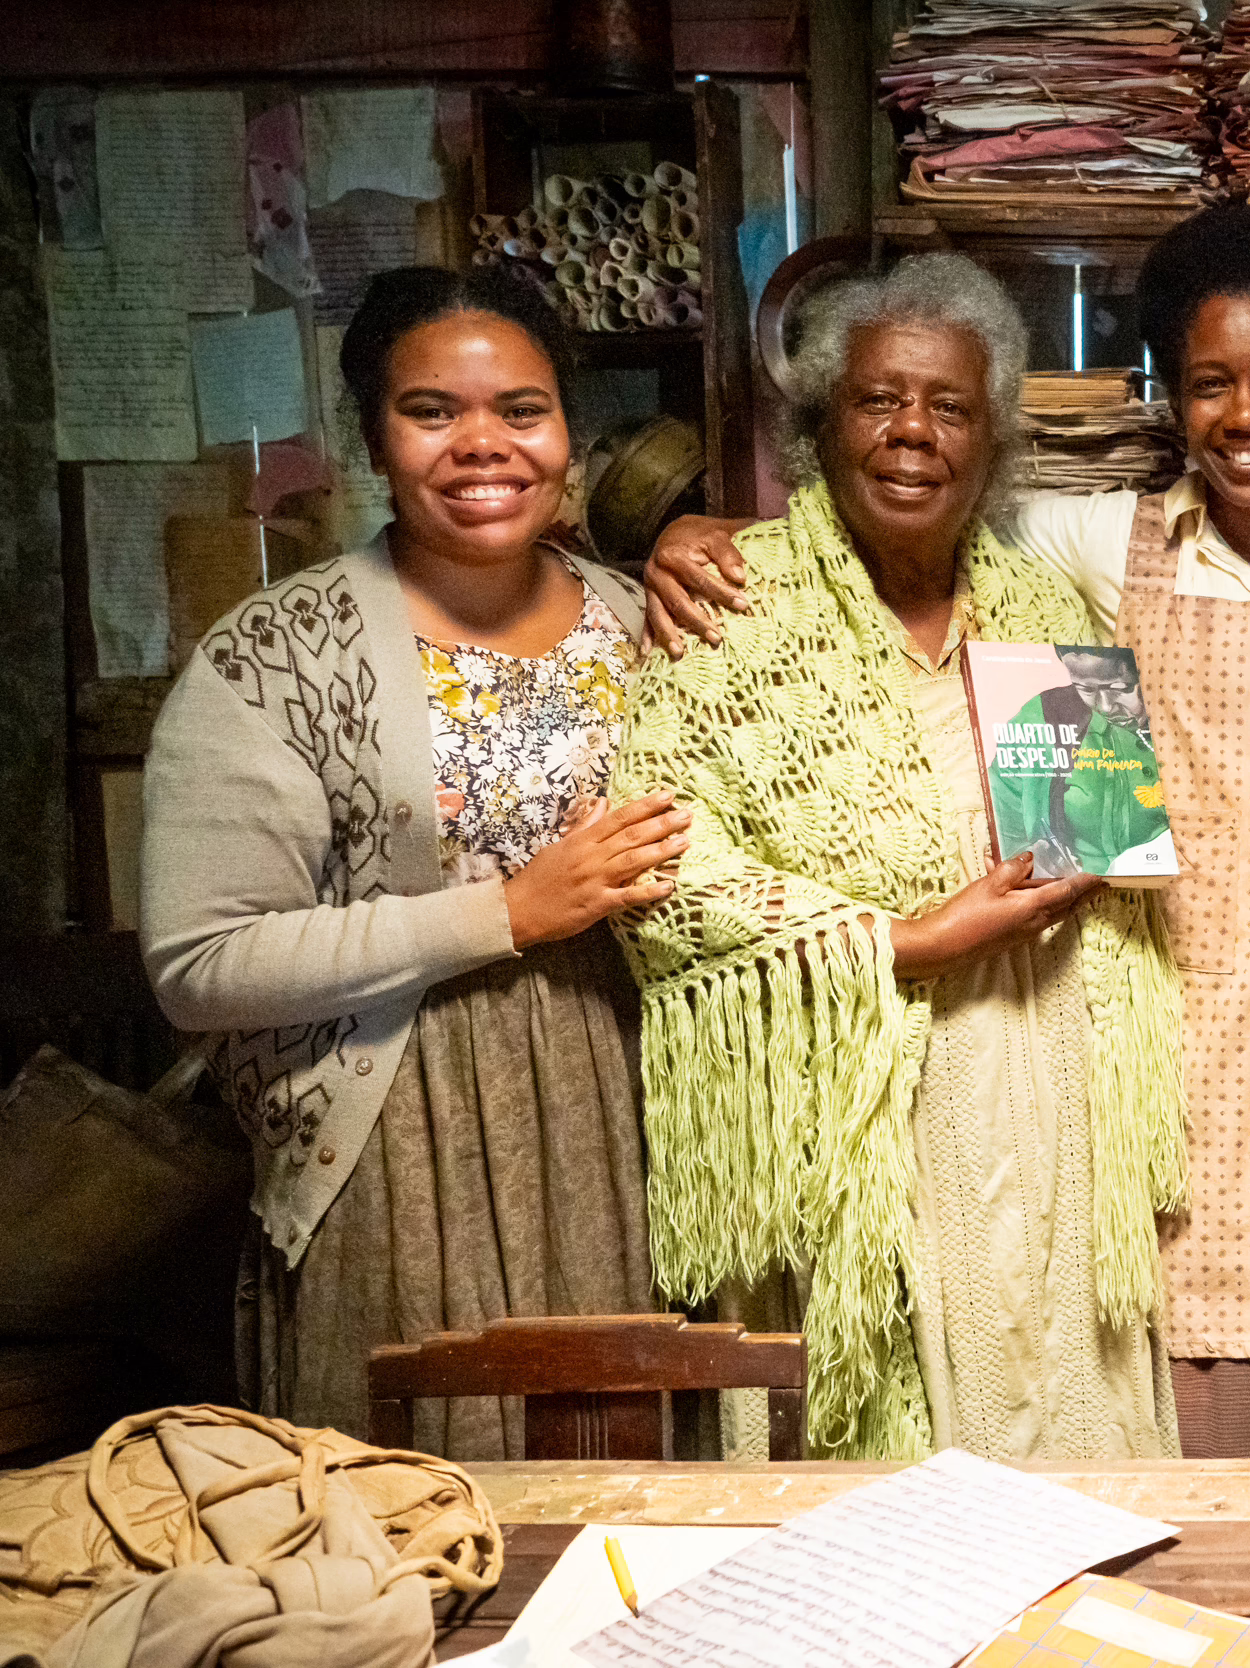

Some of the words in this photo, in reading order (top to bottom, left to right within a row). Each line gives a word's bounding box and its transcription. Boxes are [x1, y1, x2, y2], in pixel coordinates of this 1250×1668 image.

[993, 723, 1056, 745] QUARTO
[1058, 724, 1081, 745] DE
[996, 747, 1070, 769] DESPEJO
